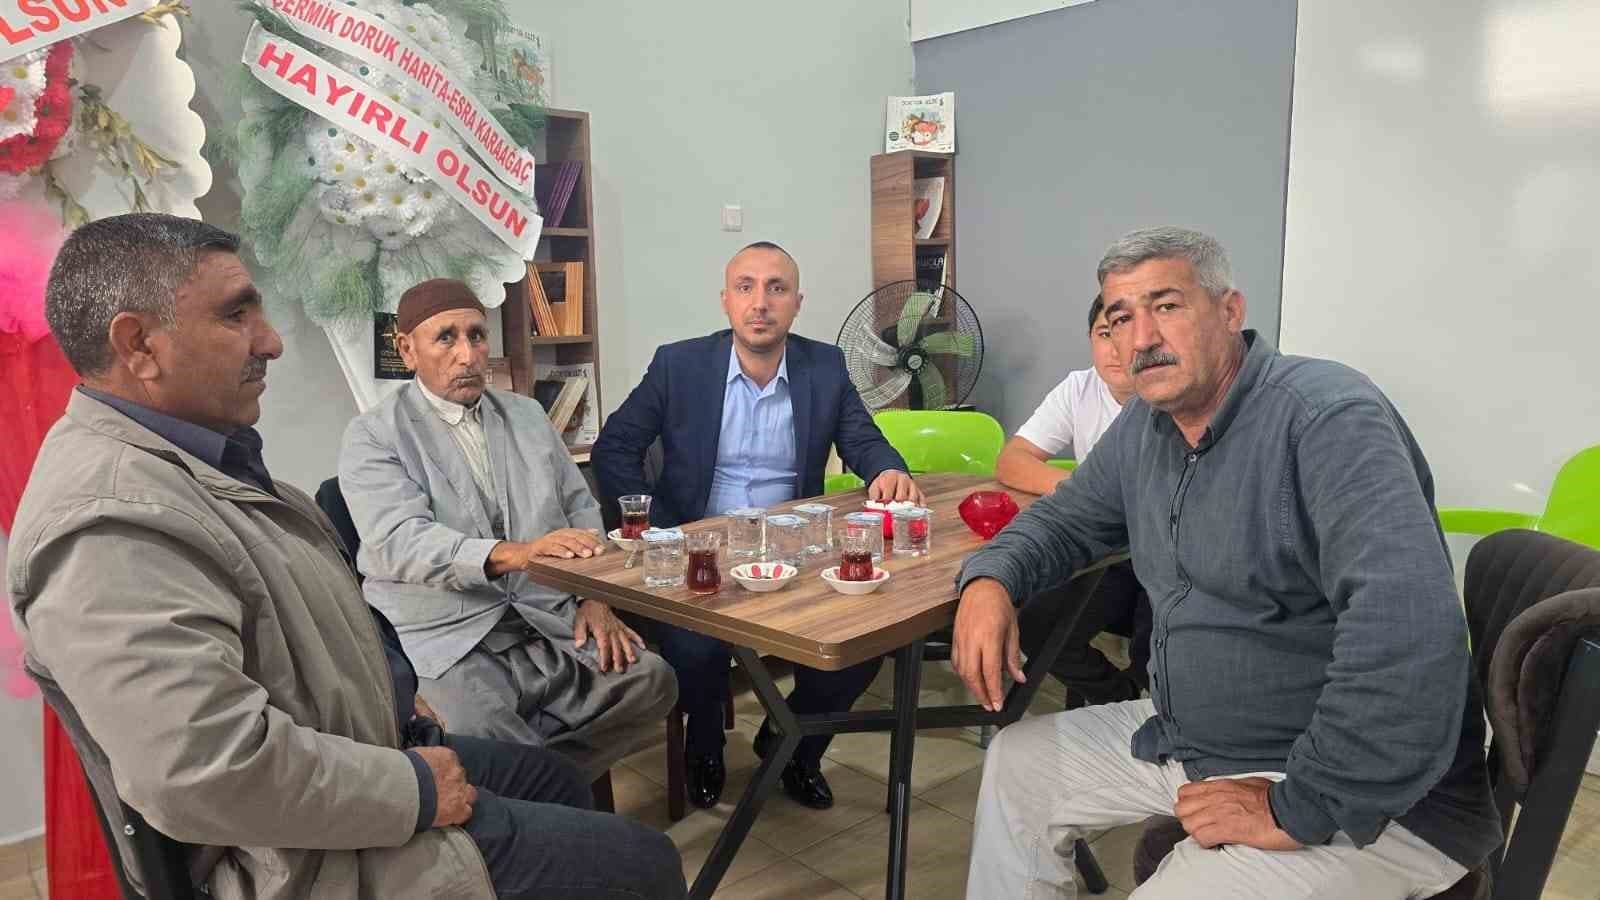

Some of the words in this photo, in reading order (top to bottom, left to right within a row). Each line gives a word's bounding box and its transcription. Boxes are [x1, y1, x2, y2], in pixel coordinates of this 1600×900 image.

[258, 42, 429, 155] HAYIRLI
[436, 148, 529, 238] OLSUN
[338, 15, 401, 62] DORUK
[397, 47, 478, 131] HARİTA-ESRA
[473, 117, 533, 184] KARAAĞAÇ
